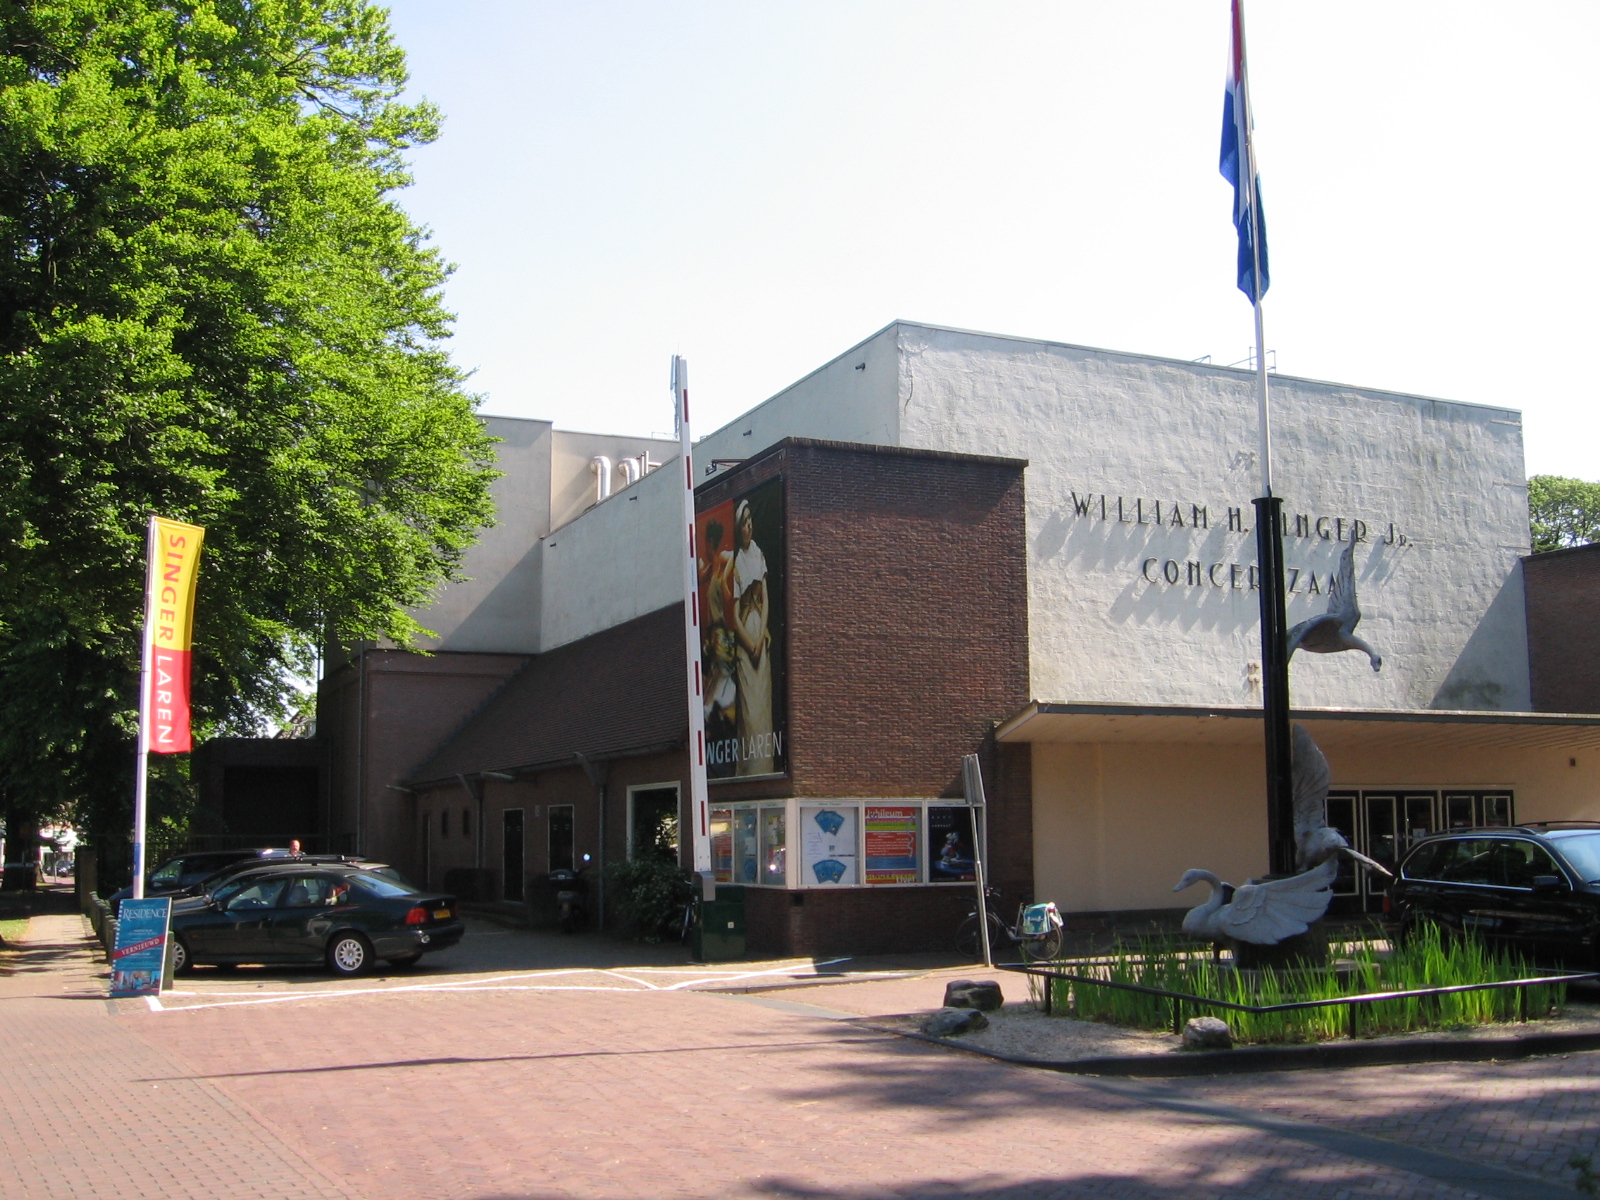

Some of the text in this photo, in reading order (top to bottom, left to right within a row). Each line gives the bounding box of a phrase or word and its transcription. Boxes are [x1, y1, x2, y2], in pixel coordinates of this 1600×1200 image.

[1070, 491, 1208, 529] WILLIAM
[1228, 506, 1250, 533] H.
[1280, 511, 1368, 544] INGER
[1142, 555, 1358, 598] CONCERZAA
[157, 534, 186, 744] SINGER LAREN
[706, 731, 782, 765] NGER LAREN
[122, 908, 168, 921] RESIDENCE
[121, 938, 160, 956] VERNIEUWD
